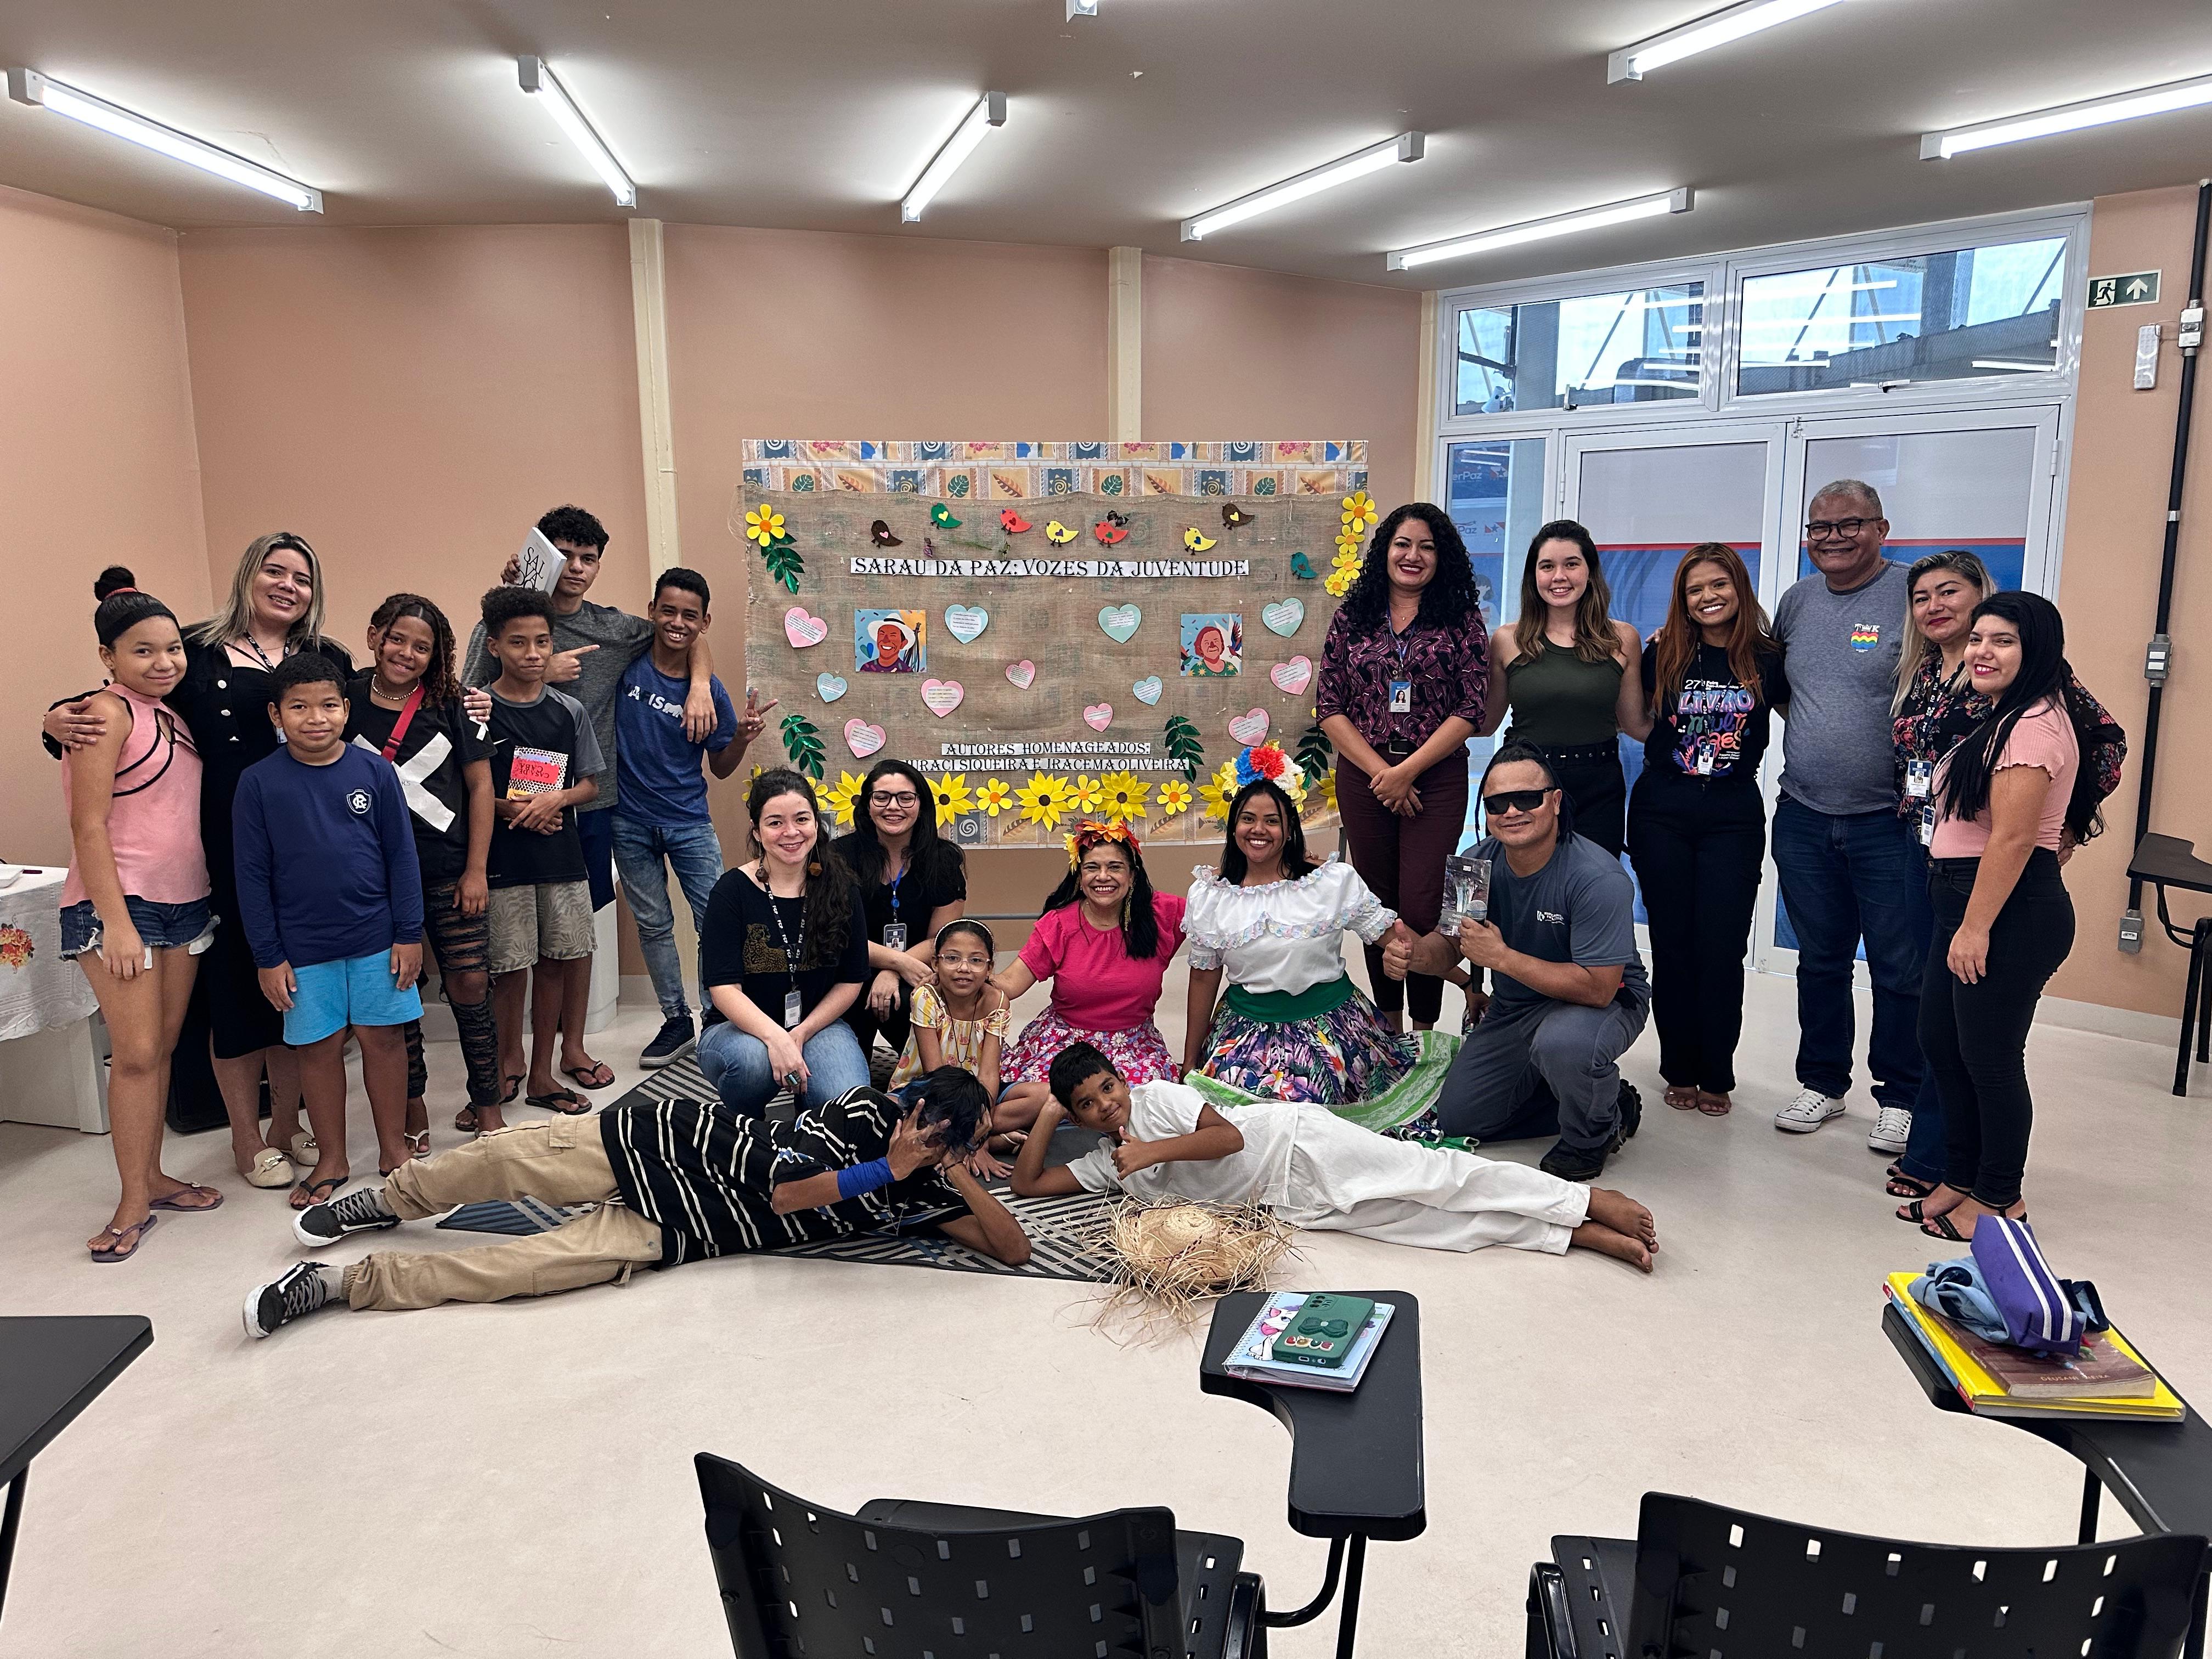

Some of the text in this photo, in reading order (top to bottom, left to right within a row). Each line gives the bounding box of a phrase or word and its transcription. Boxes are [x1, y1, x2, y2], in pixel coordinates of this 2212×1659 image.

[855, 557, 1246, 576] SARAU DA PAZ: VOZES DA JUVENTUDE
[946, 742, 1150, 755] AUTORES HOMENAGEADOS:
[960, 759, 1028, 771] SIQUEIRA
[1032, 758, 1041, 769] E
[1047, 759, 1114, 770] IRACEMA
[1118, 758, 1187, 771] OLIVEIRA
[531, 769, 550, 778] CASA
